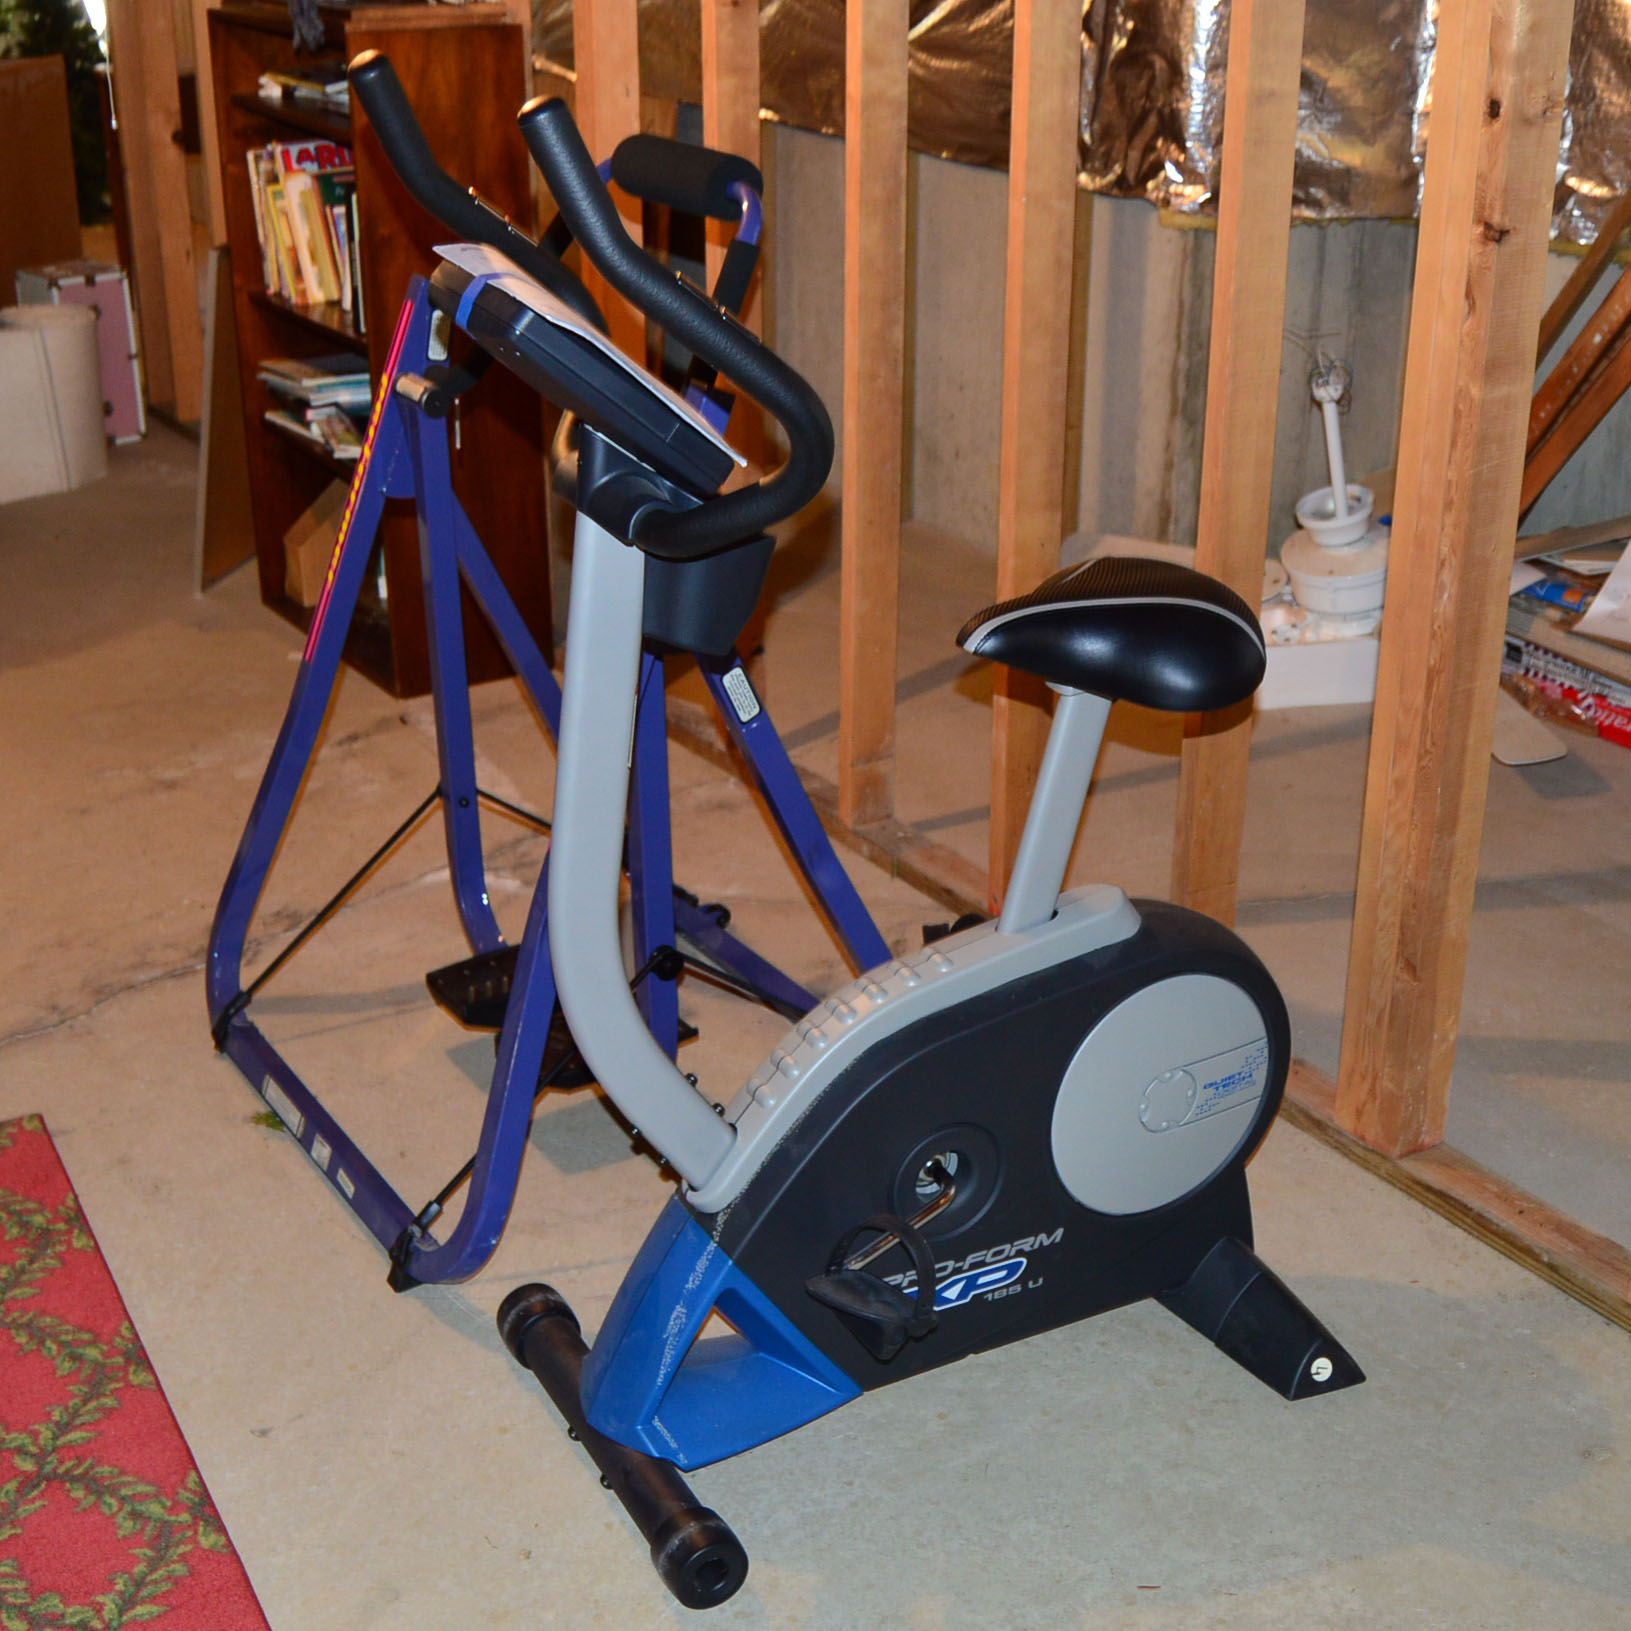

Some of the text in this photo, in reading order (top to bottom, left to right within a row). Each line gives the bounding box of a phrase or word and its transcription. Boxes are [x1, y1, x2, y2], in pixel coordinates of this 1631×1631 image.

[1203, 1071, 1244, 1090] QUIET
[1214, 1071, 1253, 1092] TECH
[1028, 1276, 1043, 1289] U
